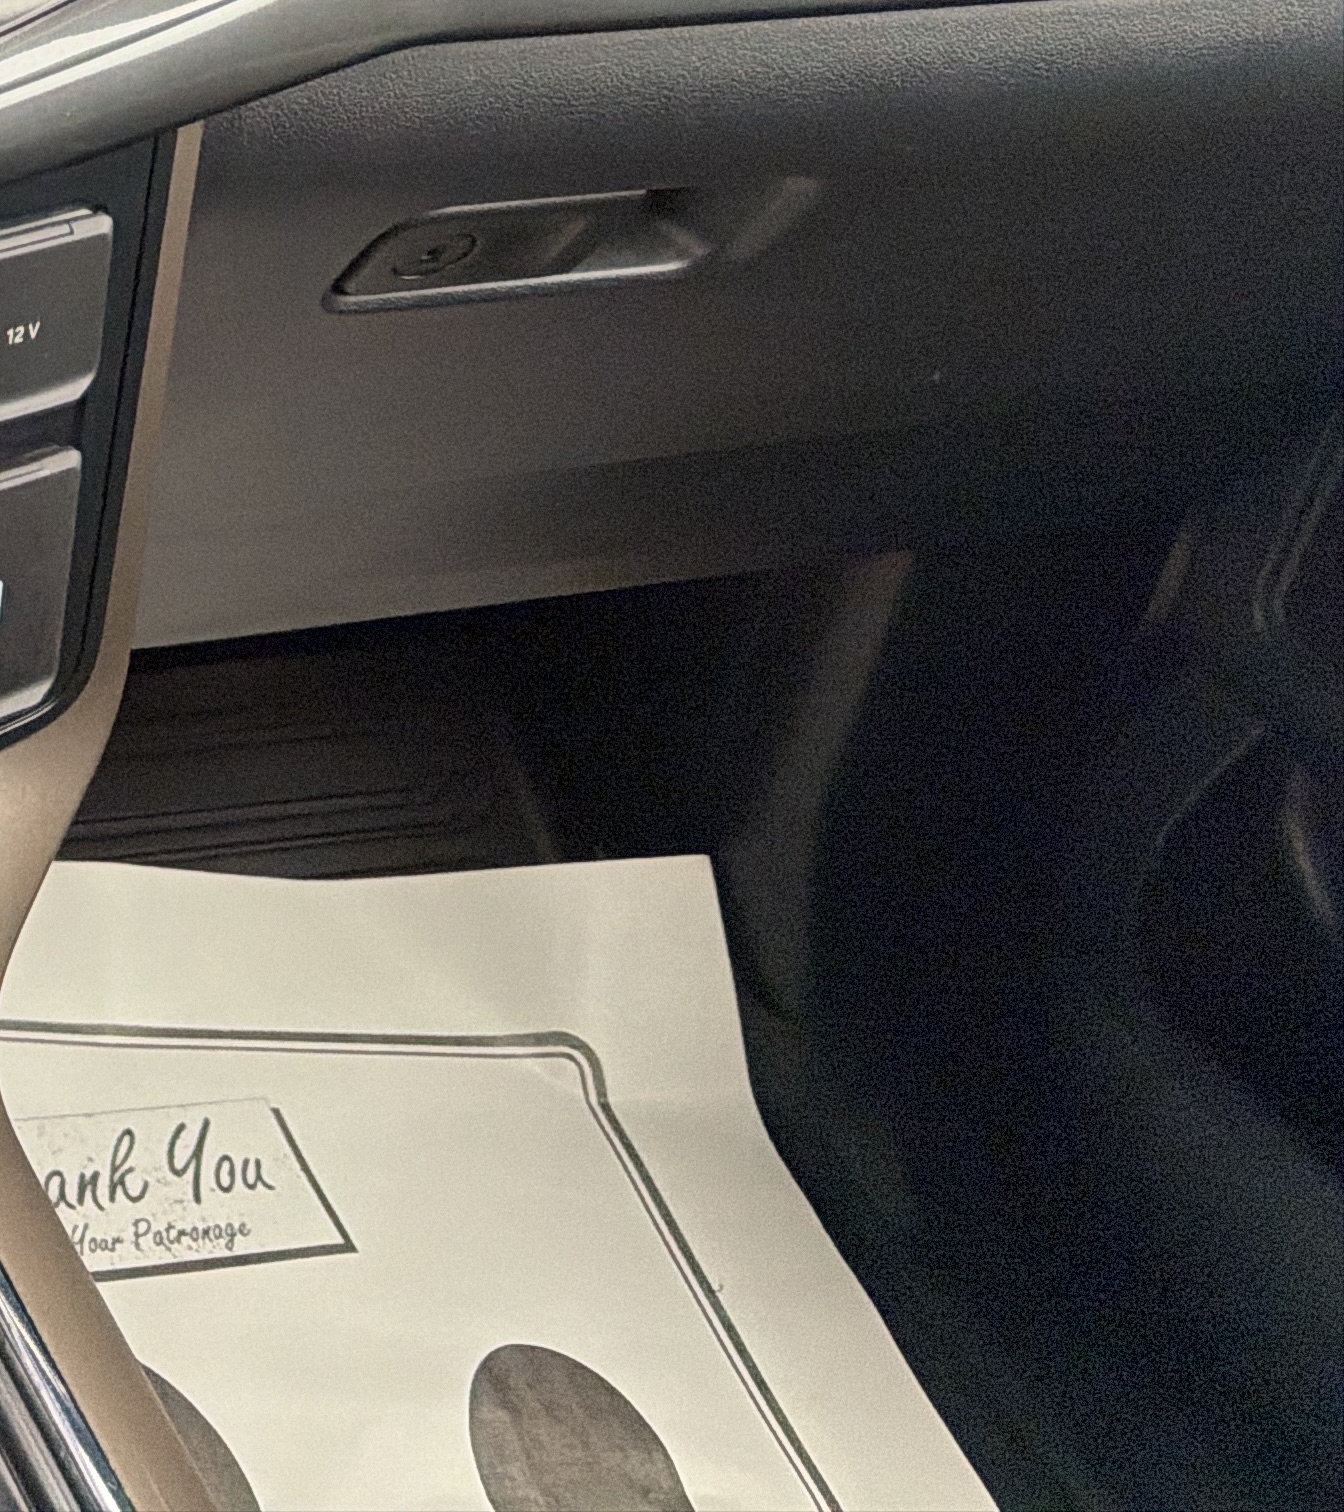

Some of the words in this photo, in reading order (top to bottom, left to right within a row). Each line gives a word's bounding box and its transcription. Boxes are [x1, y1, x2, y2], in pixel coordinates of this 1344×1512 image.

[6, 325, 25, 345] 12
[28, 321, 40, 340] V
[43, 1127, 149, 1212] ank
[167, 1117, 276, 1204] You
[132, 1217, 251, 1252] Patronage
